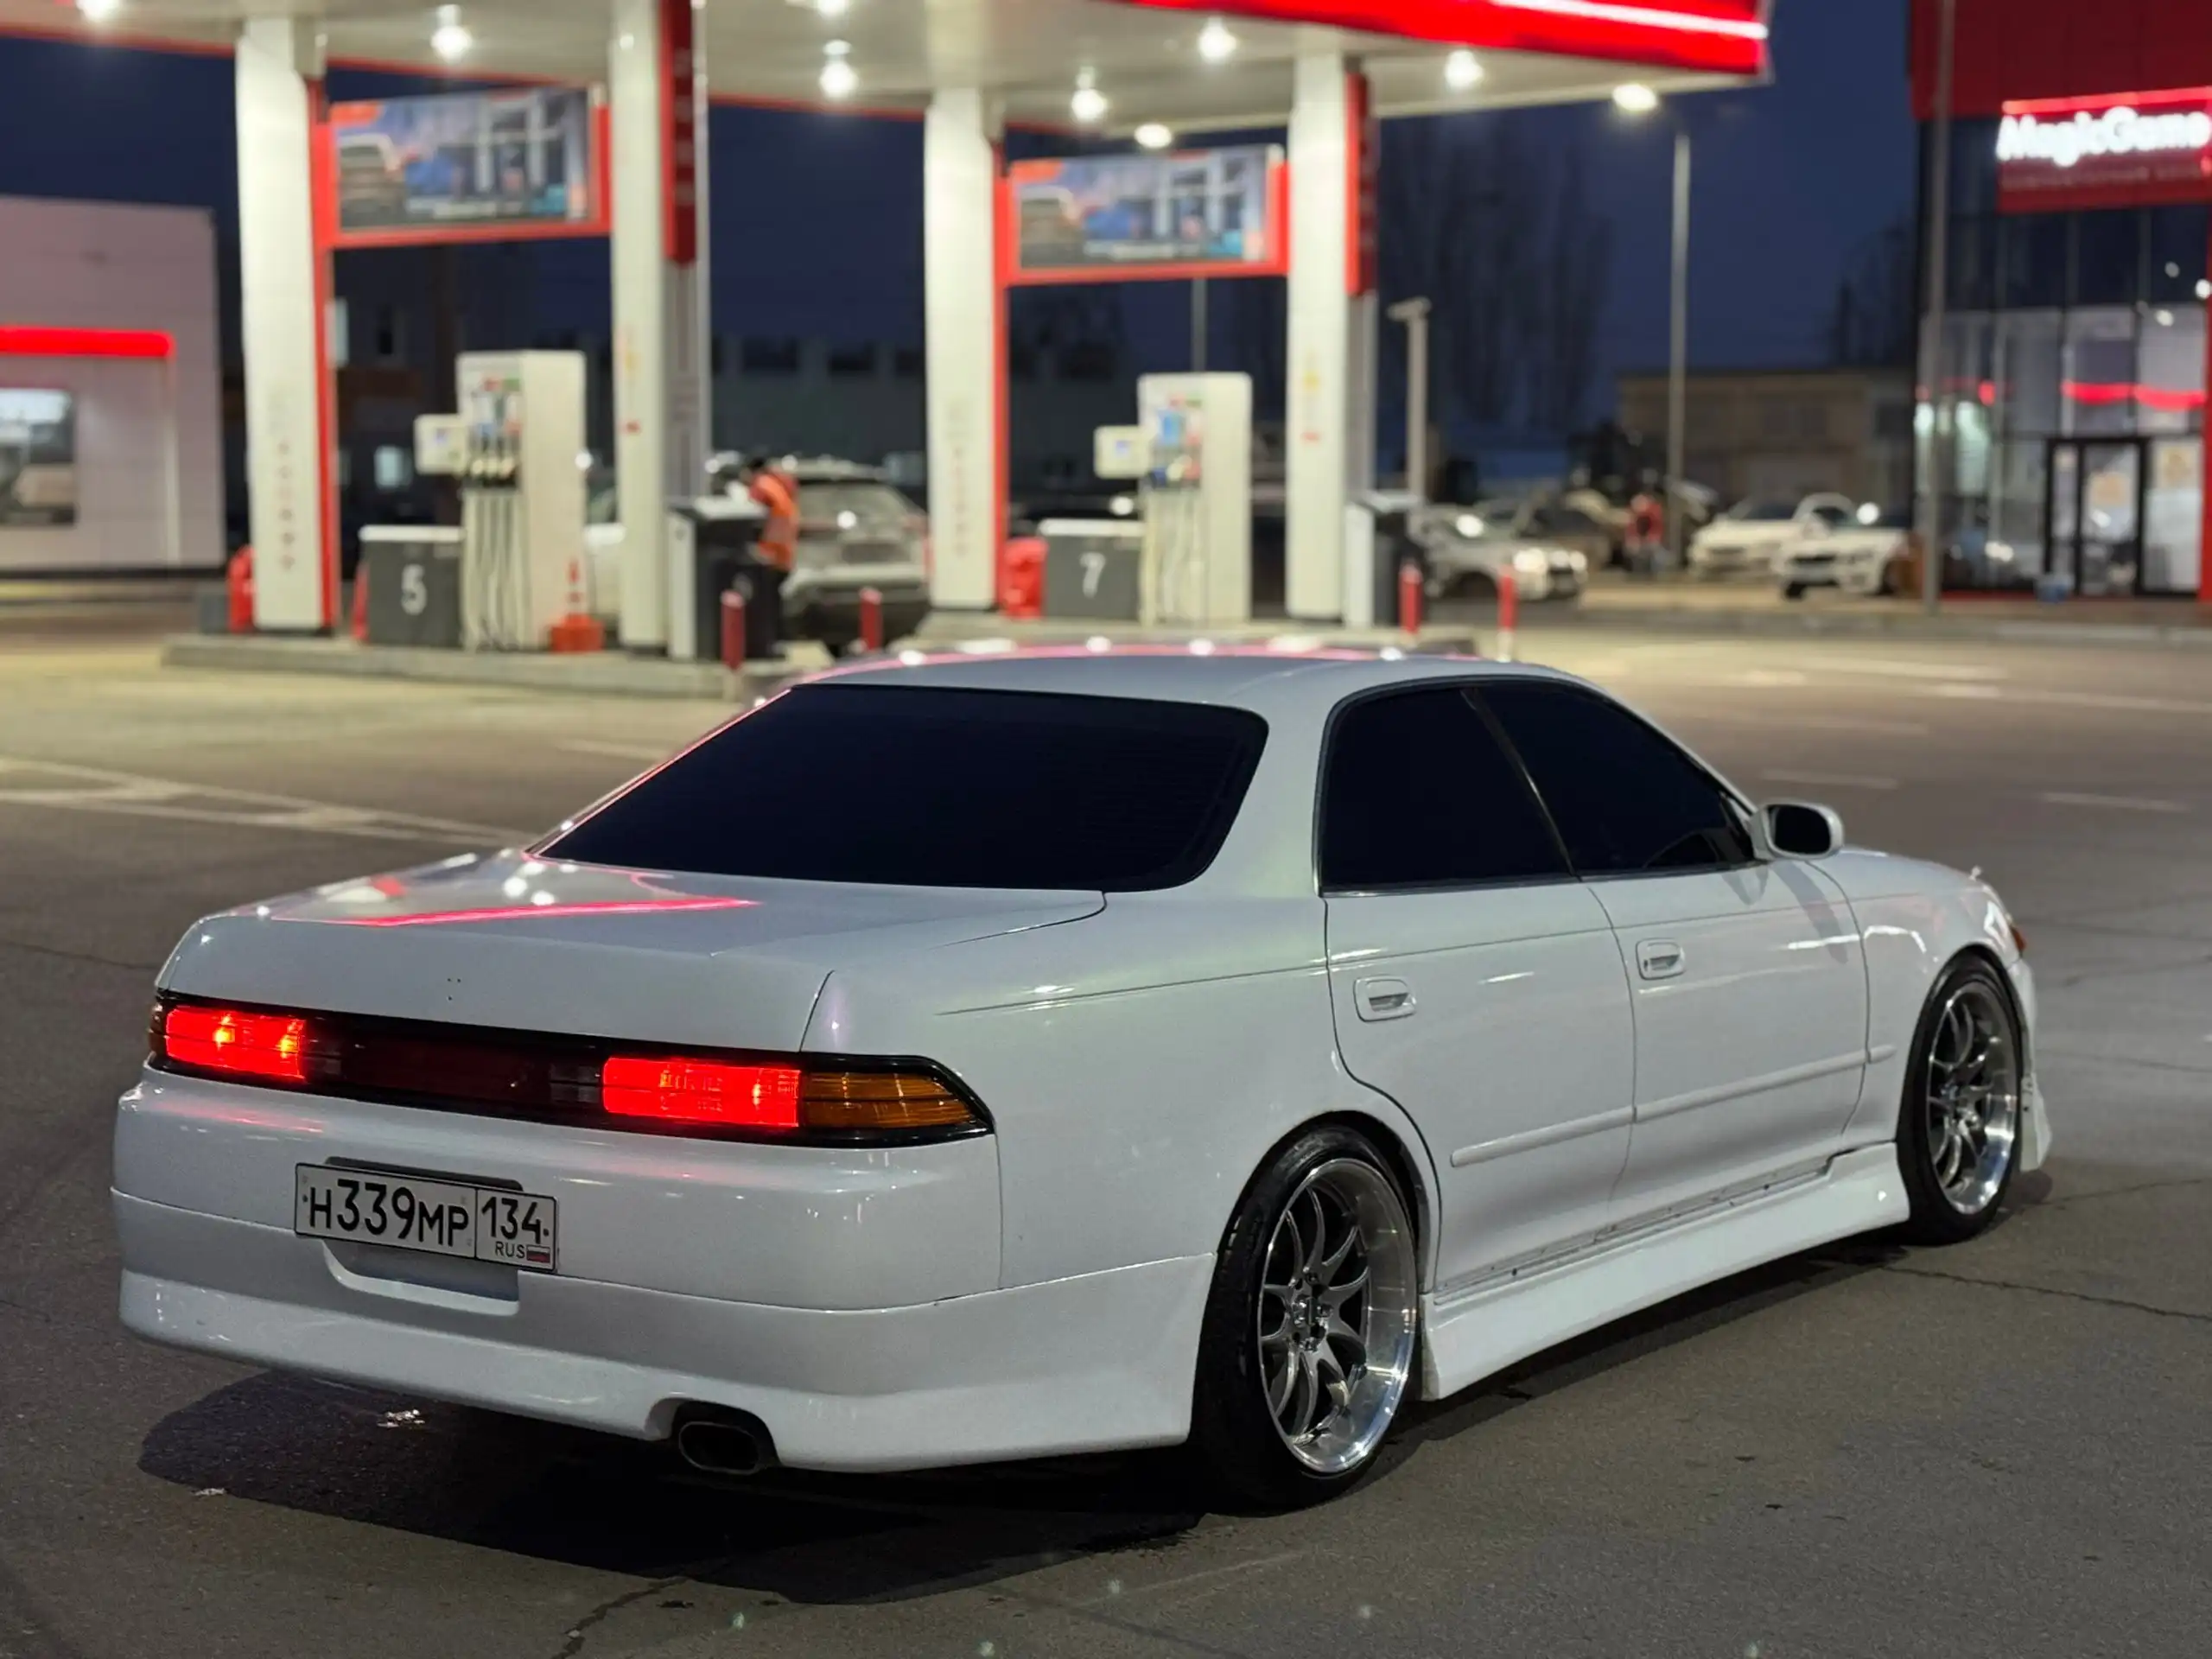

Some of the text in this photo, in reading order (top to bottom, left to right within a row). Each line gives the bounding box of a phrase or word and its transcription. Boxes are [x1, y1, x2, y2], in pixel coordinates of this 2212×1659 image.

[401, 563, 426, 615] 5
[1079, 552, 1106, 599] 7
[309, 1179, 542, 1246] Н339МР 134
[494, 1241, 525, 1259] RUS
